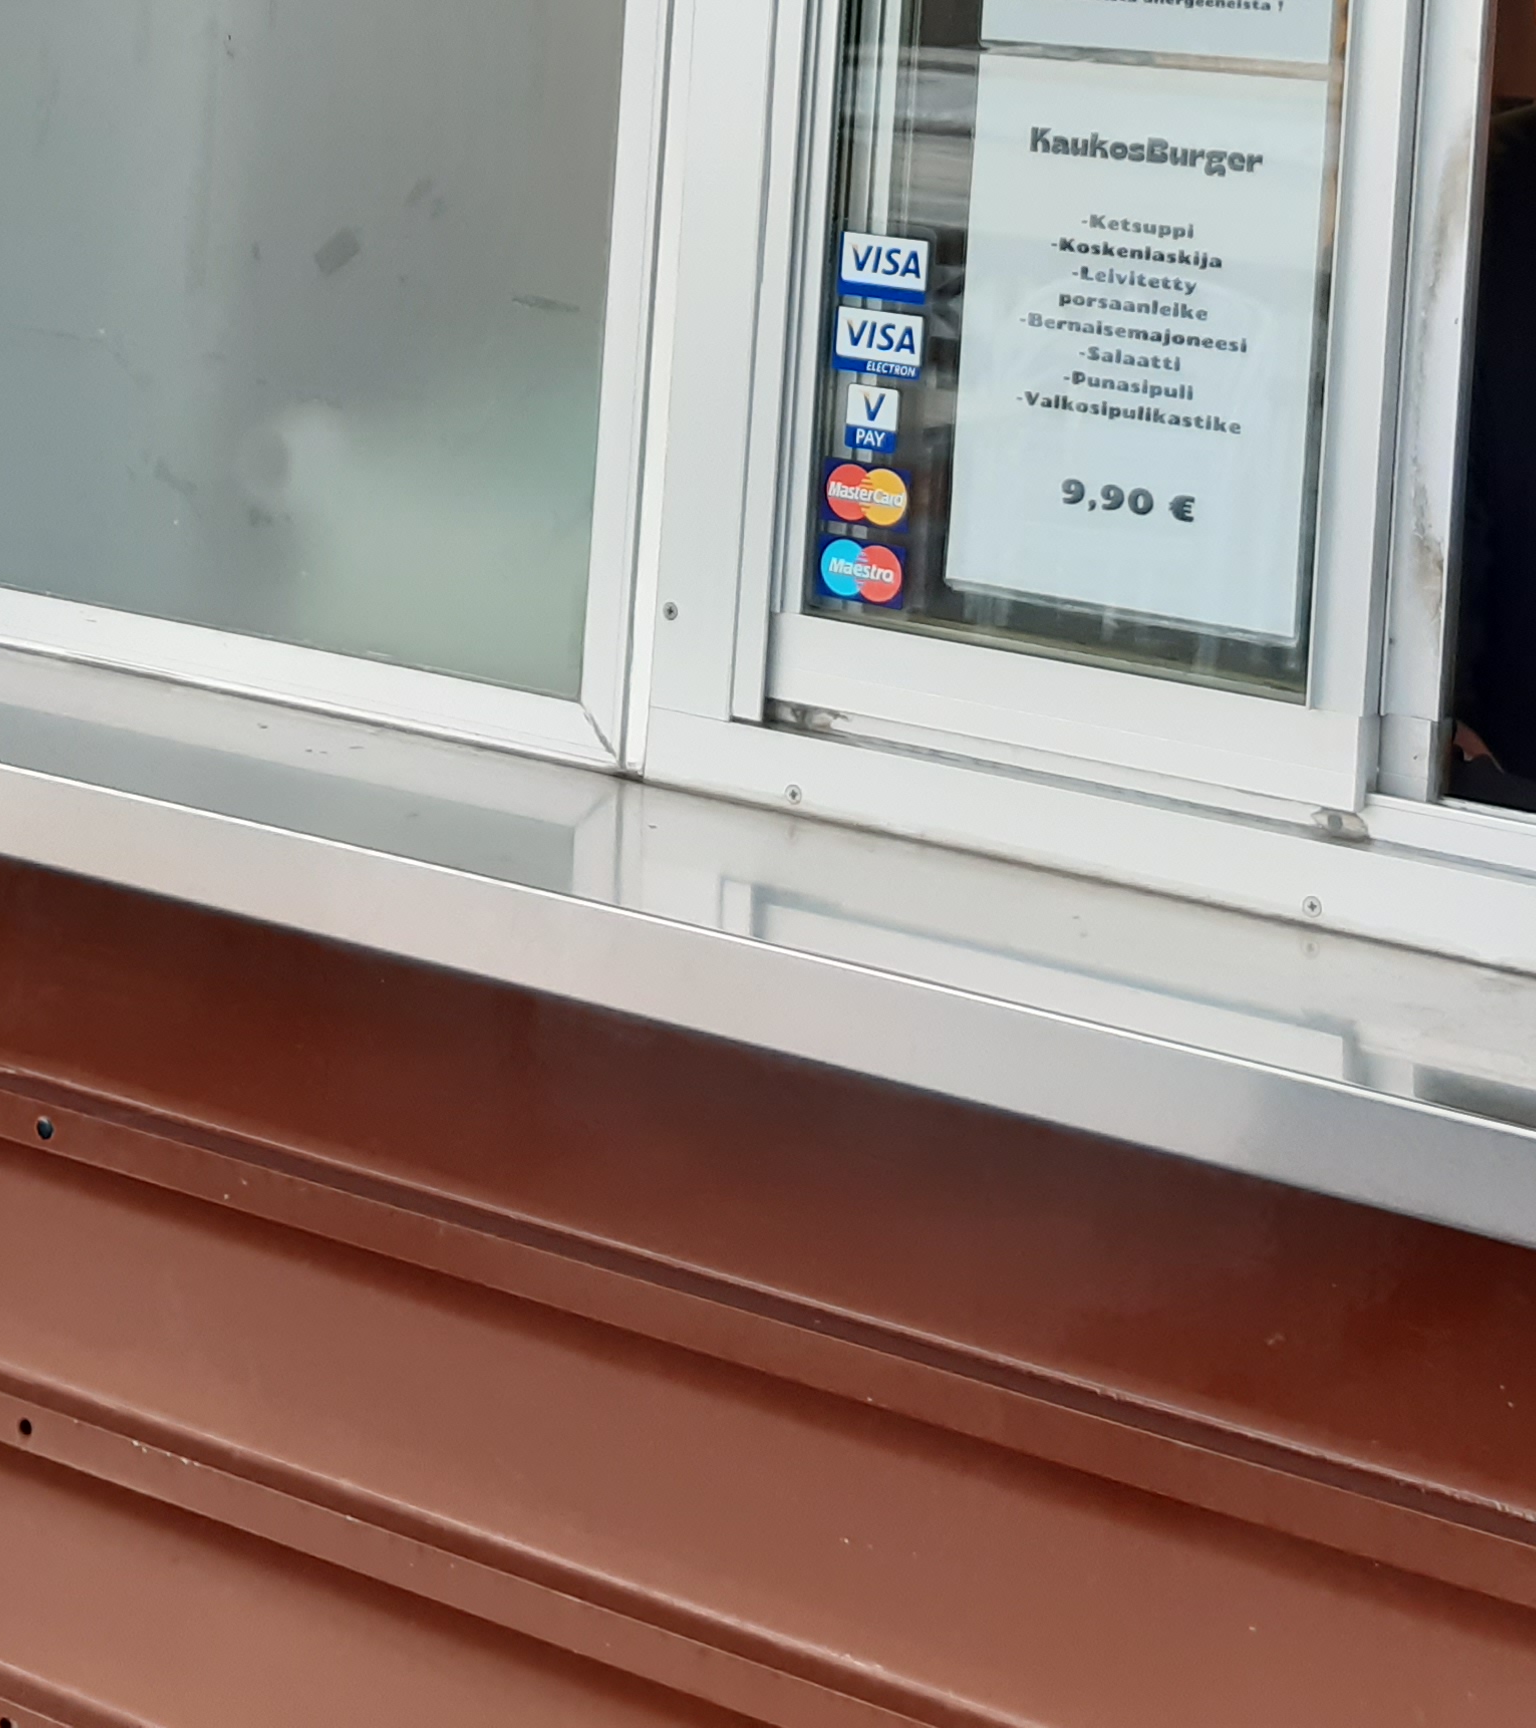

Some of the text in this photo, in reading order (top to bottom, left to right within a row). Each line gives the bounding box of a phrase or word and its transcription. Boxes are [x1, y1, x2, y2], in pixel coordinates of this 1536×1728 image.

[1028, 126, 1265, 177] KaukosBurger
[1080, 214, 1196, 240] -Ketsuppi
[850, 244, 922, 280] VISA
[1050, 237, 1224, 270] -Koskenlaskija
[1071, 266, 1198, 295] -Leivitetty
[1058, 293, 1209, 321] porsaanleike
[846, 318, 916, 355] VISA
[1018, 312, 1248, 354] -Bernaisemajoneesi
[865, 360, 917, 378] ELECTRON
[1078, 346, 1182, 372] -Salaatti
[1062, 370, 1195, 402] -Punasipuli
[859, 389, 886, 422] V
[1015, 390, 1243, 435] -Valkosipulikastike
[854, 428, 886, 449] PAY
[827, 480, 905, 508] MasterCard
[1060, 478, 1196, 523] 9,90 €
[828, 557, 894, 584] Maestro
